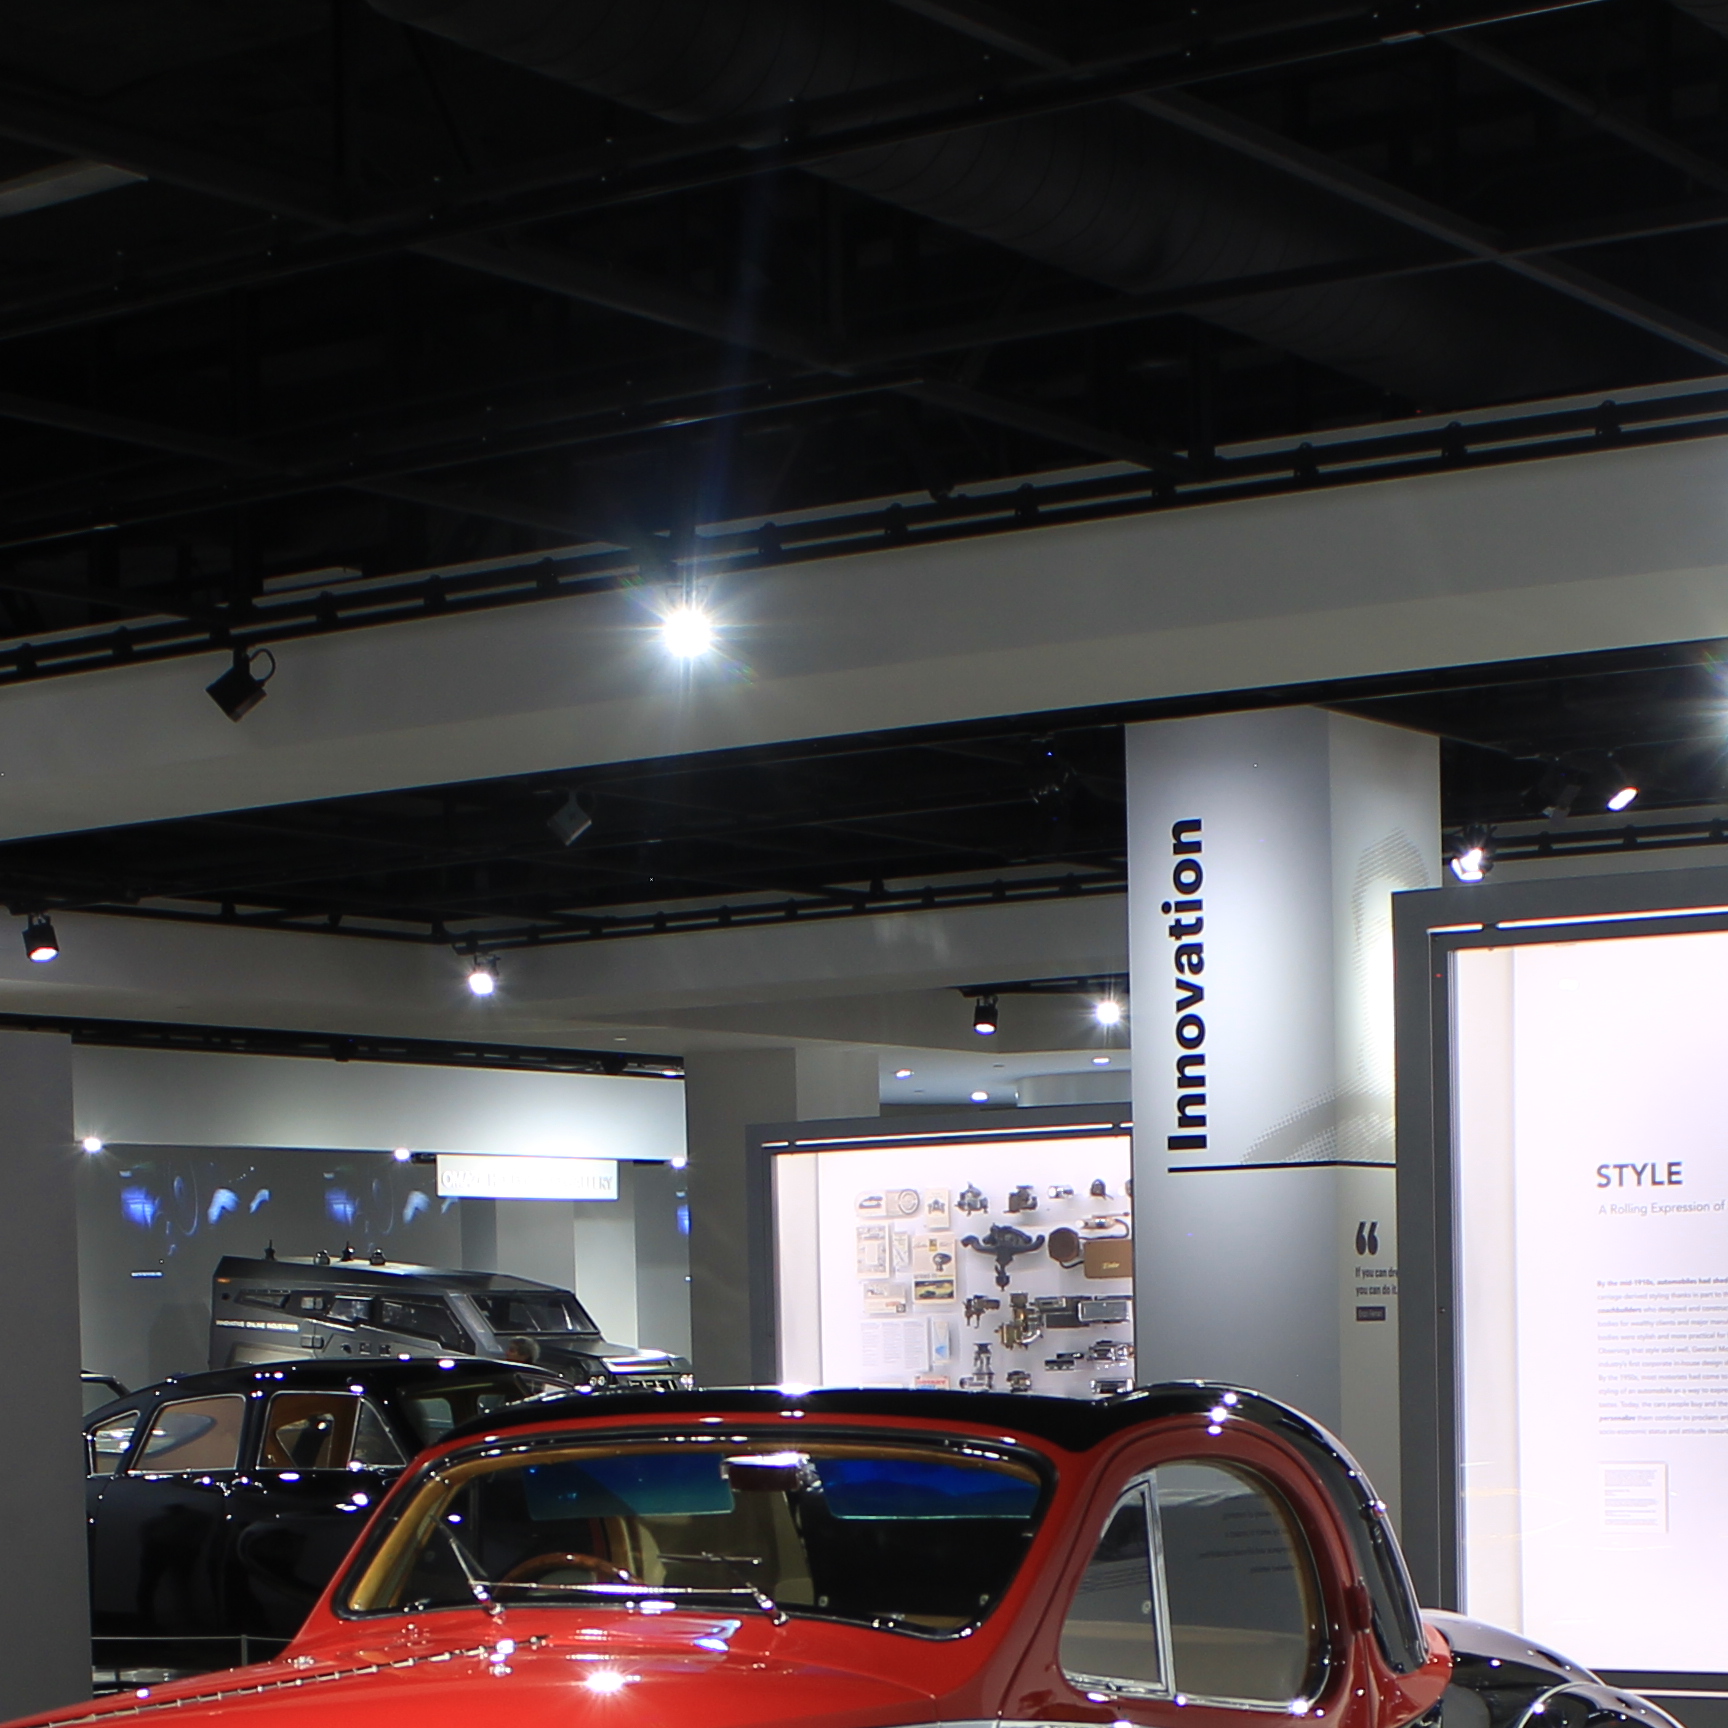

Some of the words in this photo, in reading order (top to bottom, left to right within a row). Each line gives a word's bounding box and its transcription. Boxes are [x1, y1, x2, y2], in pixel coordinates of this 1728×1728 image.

[1162, 818, 1207, 1150] Innovation
[1597, 1162, 1682, 1188] STYLE
[1599, 1205, 1607, 1214] A
[1610, 1203, 1647, 1217] Rolling
[1651, 1201, 1710, 1215] Expression
[1713, 1199, 1725, 1211] of
[1361, 1268, 1374, 1280] you
[1375, 1268, 1387, 1278] can
[1657, 1277, 1697, 1286] automobiles
[1713, 1276, 1728, 1285] shed
[1356, 1286, 1368, 1297] you
[1369, 1286, 1381, 1295] can
[1382, 1284, 1391, 1295] do
